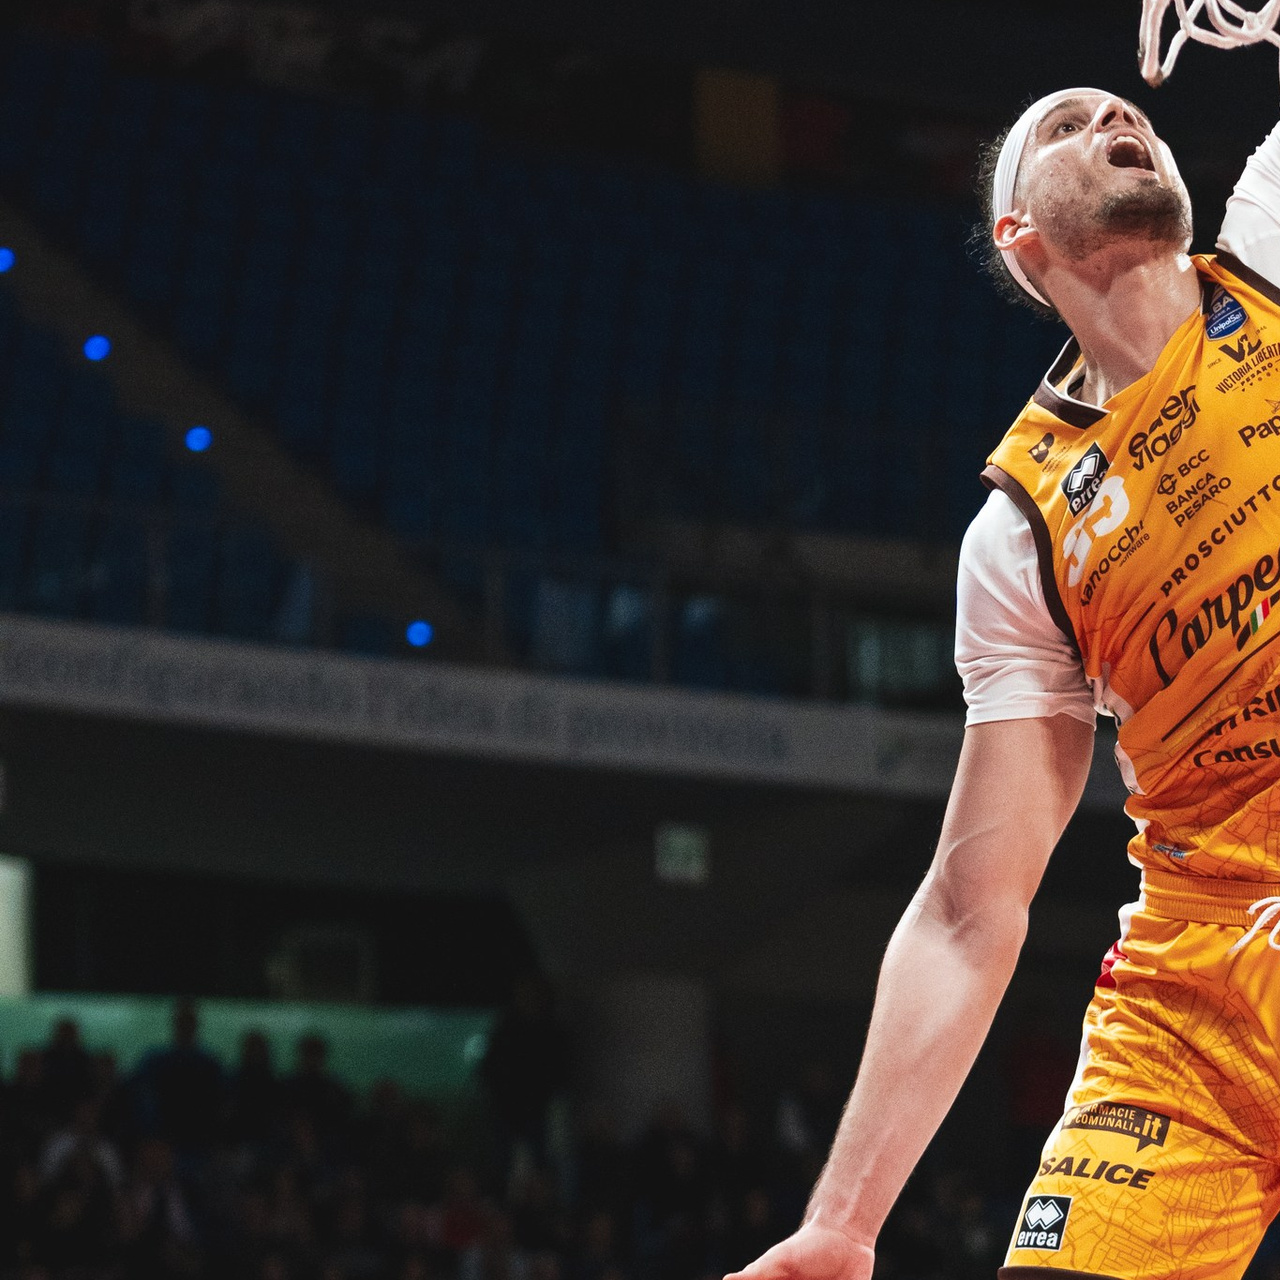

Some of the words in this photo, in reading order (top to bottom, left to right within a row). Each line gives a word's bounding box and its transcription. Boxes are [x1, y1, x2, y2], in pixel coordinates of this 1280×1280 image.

[1215, 361, 1253, 394] VICTORIA
[1240, 362, 1274, 387] PESARO
[1177, 449, 1210, 478] BCC
[1165, 472, 1217, 515] BANCA
[1173, 476, 1232, 528] PESARO
[1075, 1113, 1134, 1131] COMUNALI
[1038, 1156, 1156, 1190] SALICE
